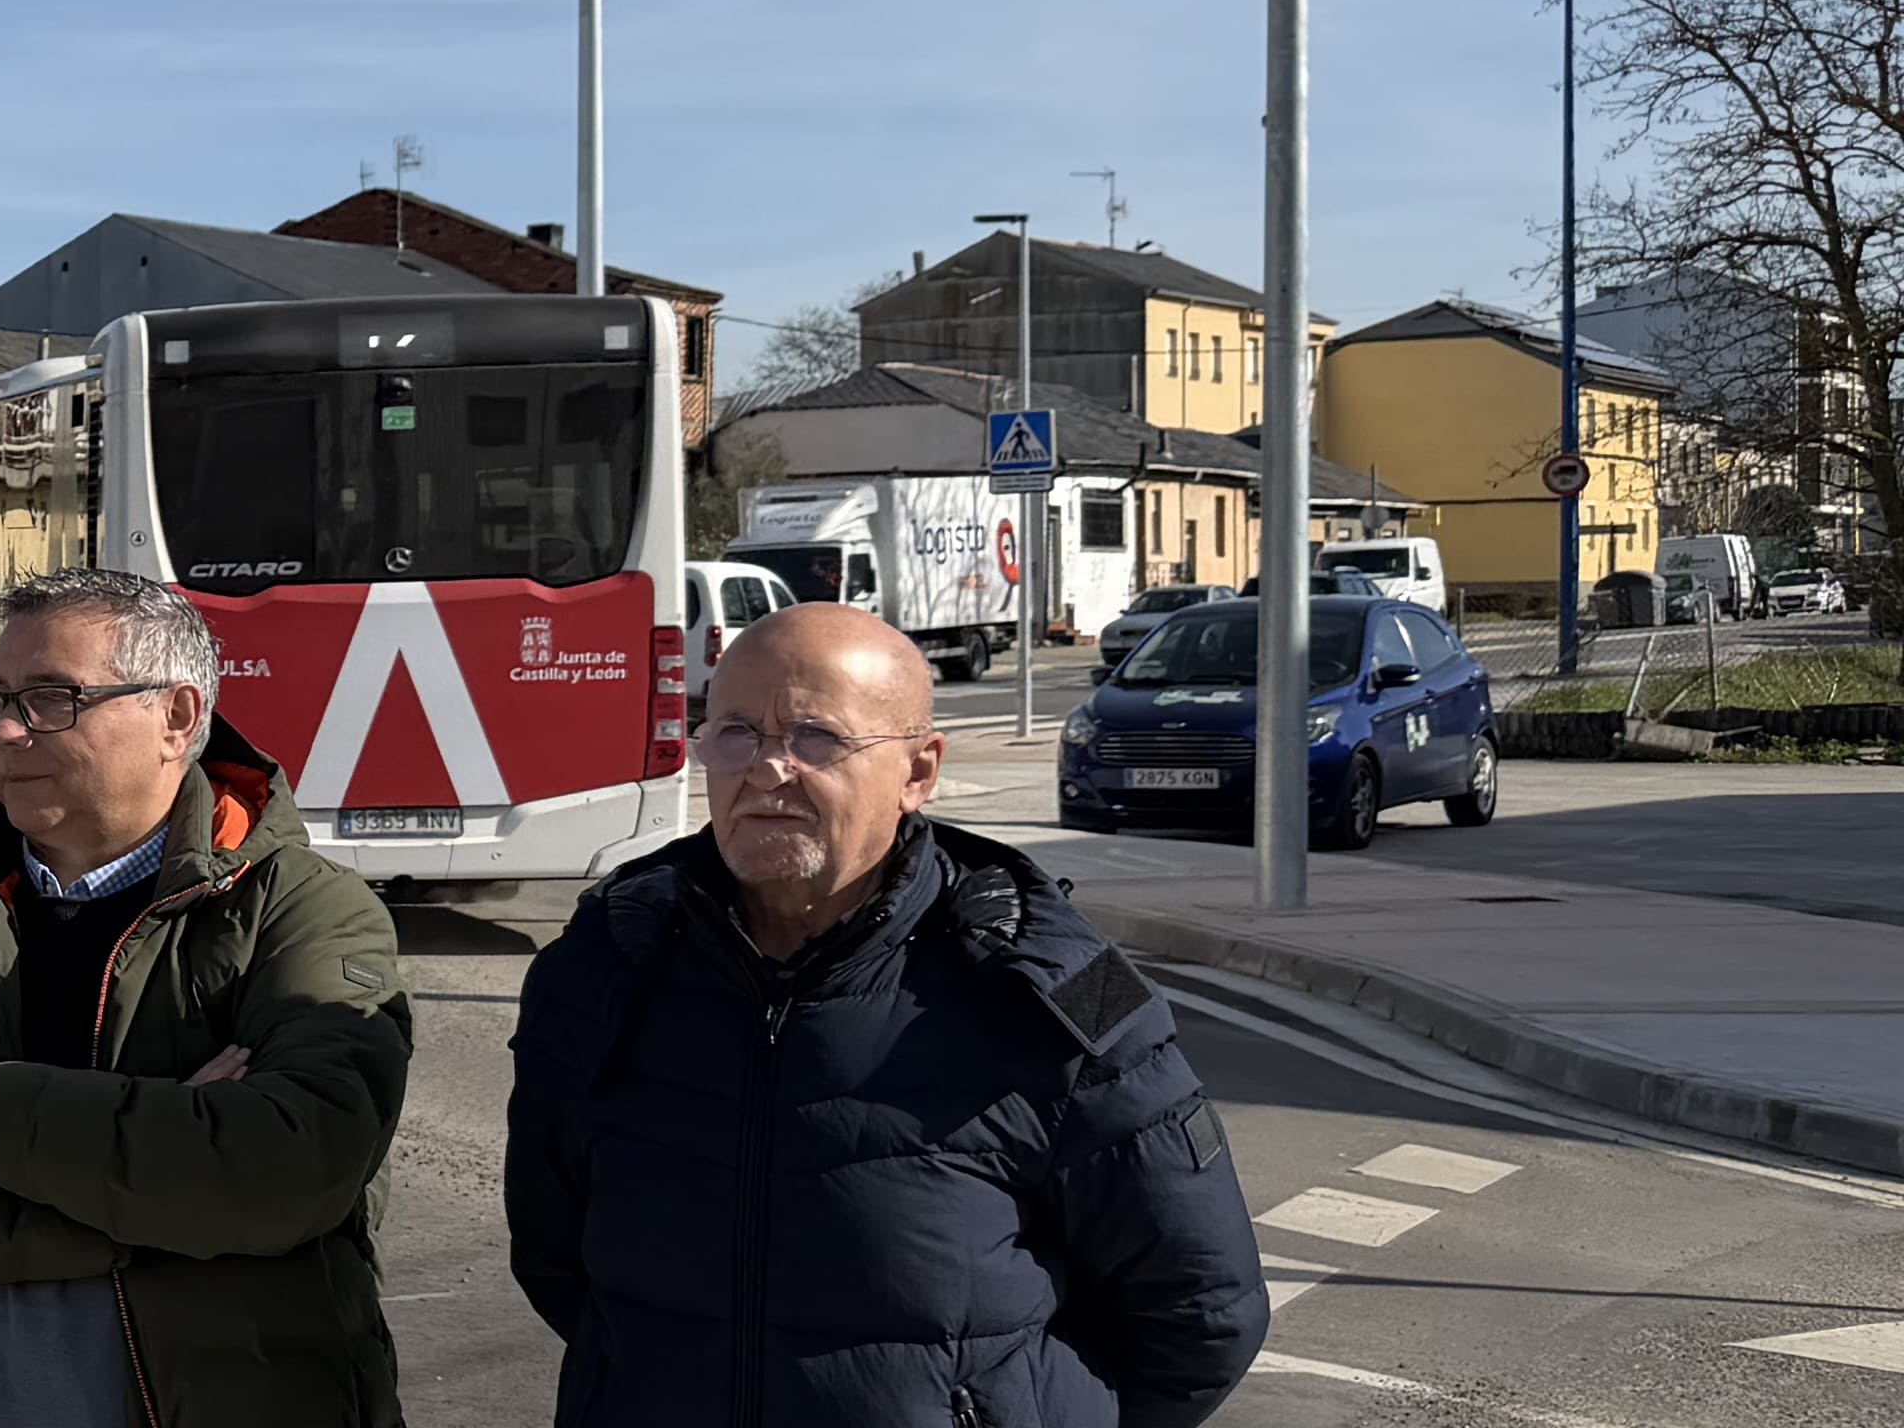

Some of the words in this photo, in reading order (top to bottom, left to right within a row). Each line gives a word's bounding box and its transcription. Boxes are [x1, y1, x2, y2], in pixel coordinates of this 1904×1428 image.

[911, 518, 986, 565] Logista
[189, 561, 303, 577] CITARO
[555, 651, 601, 664] Junta
[605, 650, 626, 664] de
[509, 666, 569, 681] Castilla
[571, 669, 583, 684] y
[586, 665, 626, 680] León
